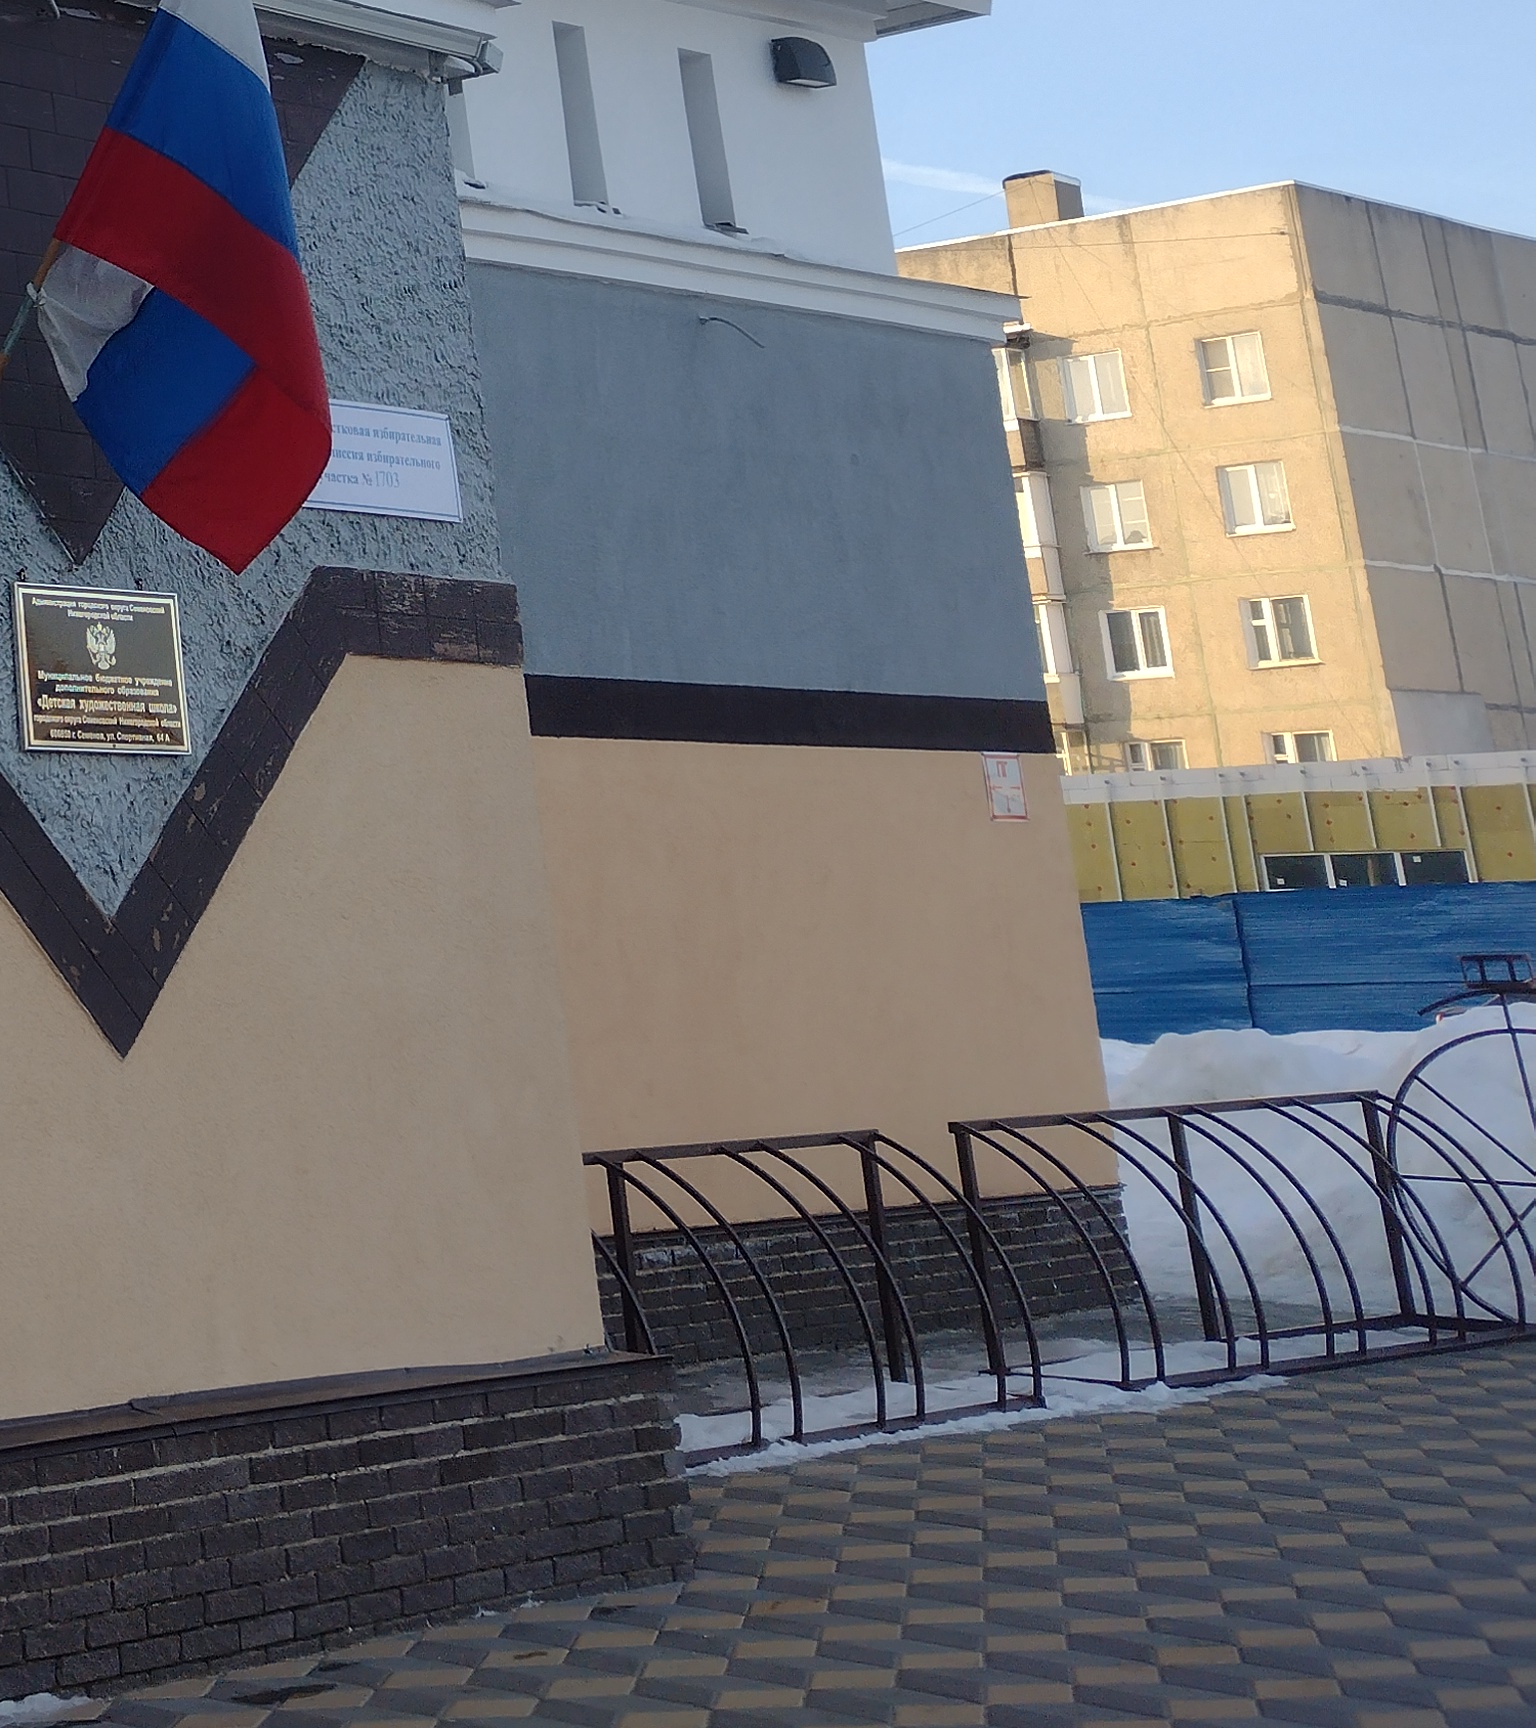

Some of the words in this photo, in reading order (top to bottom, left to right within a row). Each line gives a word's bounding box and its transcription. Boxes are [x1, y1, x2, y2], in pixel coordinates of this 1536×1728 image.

[372, 427, 442, 447] избирательная
[366, 450, 441, 470] избирательного
[319, 472, 359, 485] частка
[361, 473, 373, 487] №
[375, 471, 400, 489] 1703
[37, 694, 76, 710] «Детская
[79, 698, 145, 712] художественная
[148, 702, 177, 714] школа»
